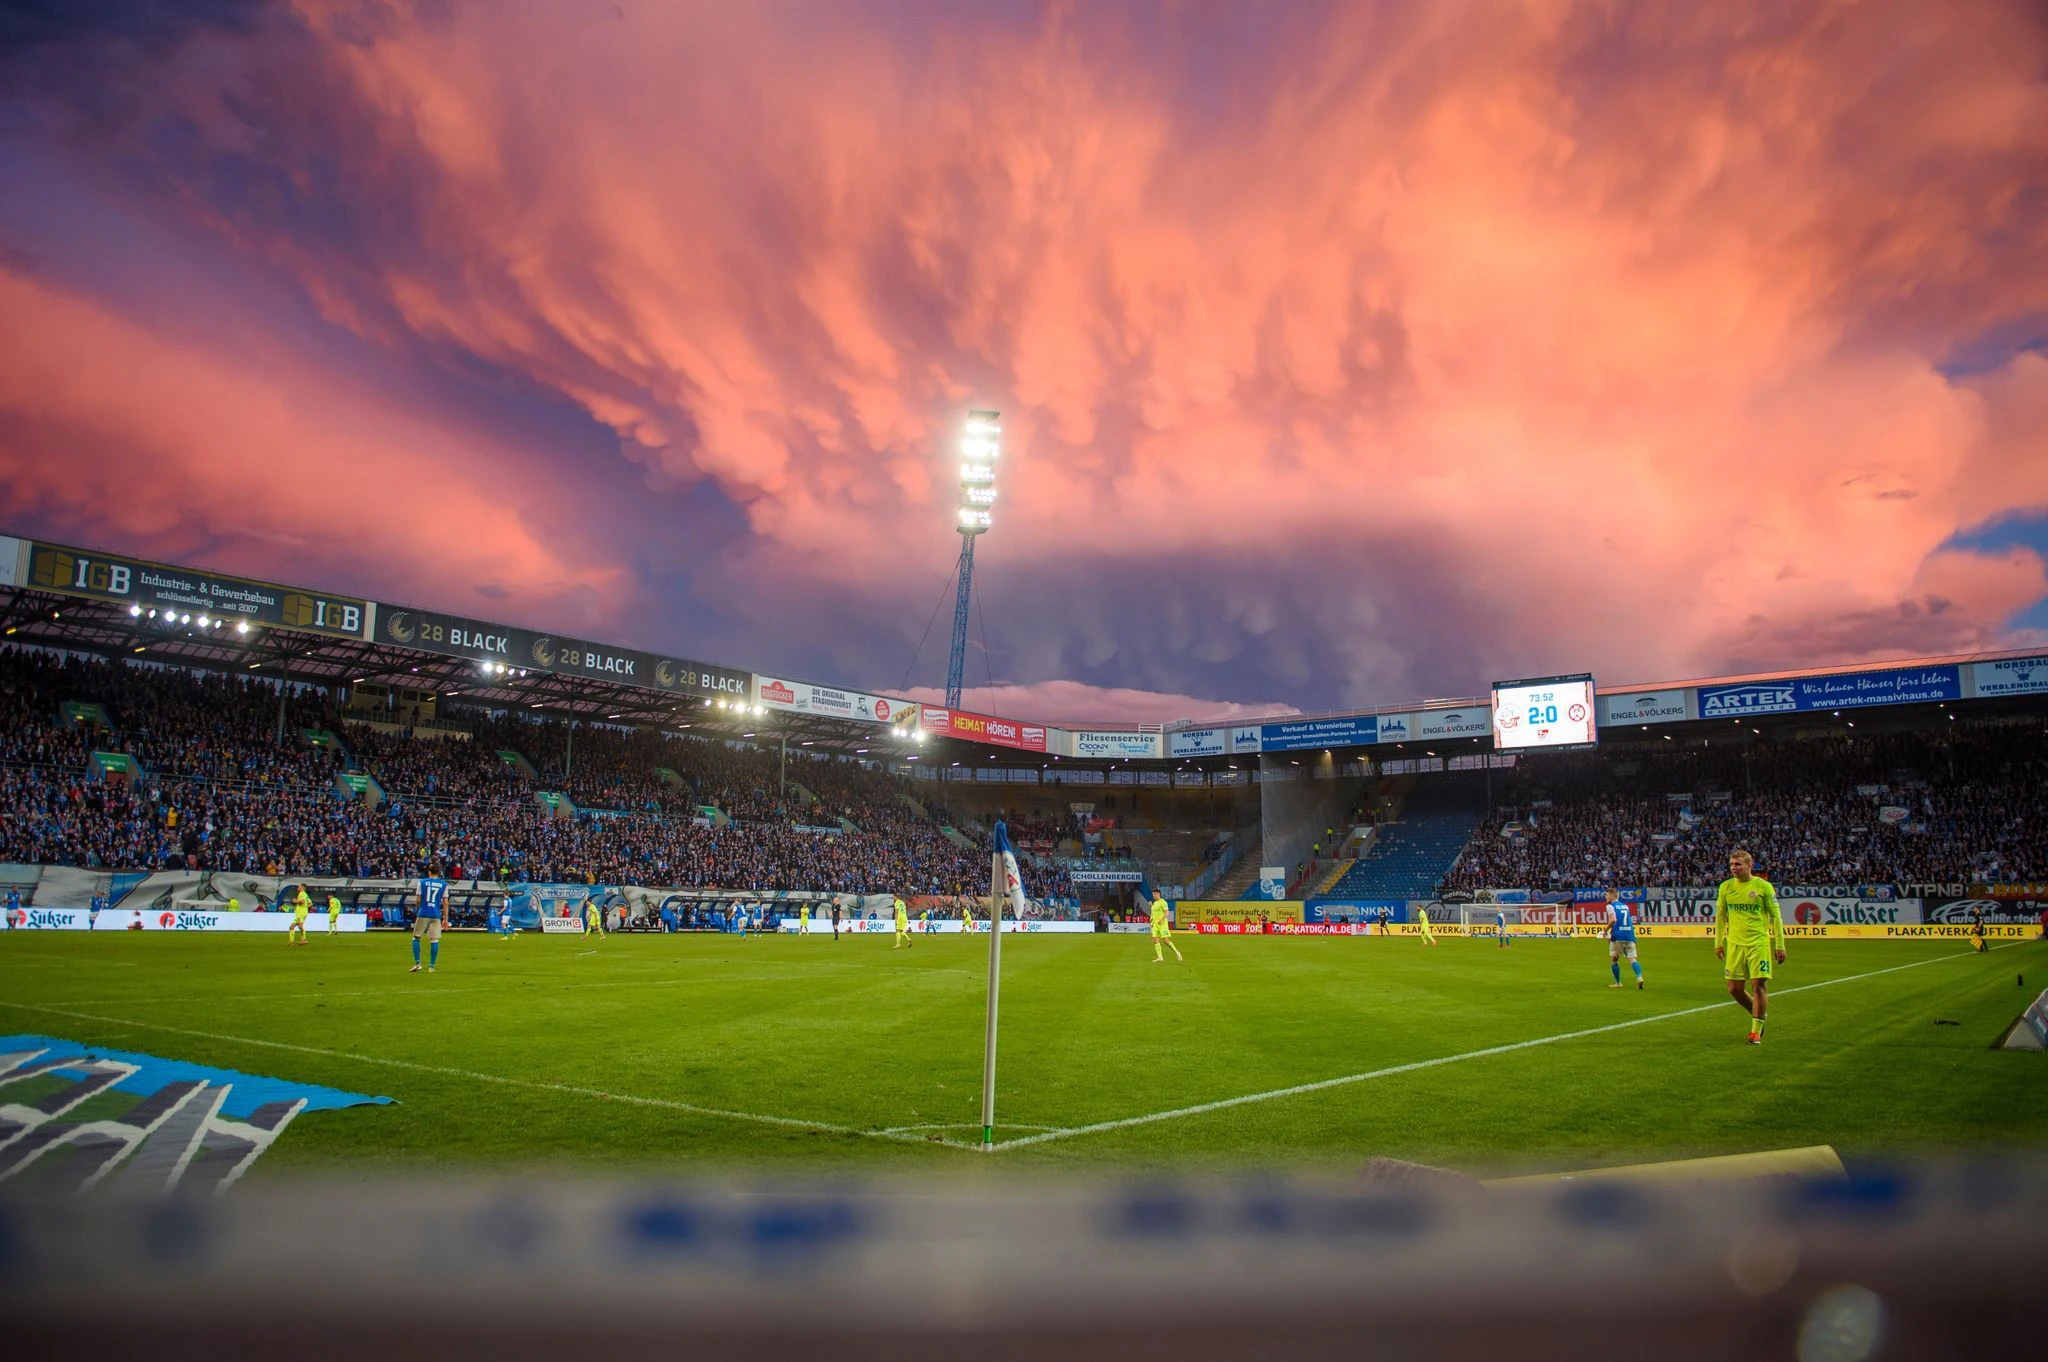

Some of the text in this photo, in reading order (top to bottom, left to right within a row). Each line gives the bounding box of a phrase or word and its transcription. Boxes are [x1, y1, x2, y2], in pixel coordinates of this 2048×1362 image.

[75, 559, 131, 594] IGB
[141, 572, 275, 605] Industrie- & Gewerbebau
[238, 603, 259, 614] 2007
[315, 600, 360, 632] IGB
[420, 623, 508, 654] 28 BLACK
[560, 648, 635, 676] 28 BLACK
[680, 669, 744, 694] 28 BLACK
[1803, 682, 1822, 694] Wir
[1825, 679, 1854, 693] bauen
[1857, 678, 1894, 691] Häuser
[1919, 672, 1951, 684] Leben
[812, 696, 852, 709] STADIONWURST
[822, 690, 846, 701] ORIGINAL
[1529, 692, 1554, 702] 73:52
[1704, 689, 1795, 709] ARTEK
[1811, 689, 1944, 707] www.artek-massivhaus.de
[1529, 705, 1557, 724] 2:0
[1611, 707, 1683, 720] ENGEL&VÖLKERS
[1707, 703, 1793, 714] MASSIVHAUS
[954, 716, 1016, 738] HEIMAT HÖREN!
[1282, 723, 1307, 733] Verkauf
[1316, 721, 1356, 731] Vermietung
[1423, 723, 1485, 735] ENGEL&VÖLKERS
[1079, 733, 1155, 743] Fliesenservice
[1071, 872, 1141, 881] SCHOLLENBERGER
[426, 886, 439, 903] 17
[1897, 883, 1964, 898] VTPNB
[1206, 908, 1270, 916] Plakat-verkauft.de
[1734, 903, 1760, 911] BRITA
[1825, 900, 1900, 925] Lübzer
[27, 910, 76, 928] Lübzer
[176, 911, 219, 929] Lübzer
[544, 918, 572, 927] GROTH
[1620, 909, 1628, 926] 7
